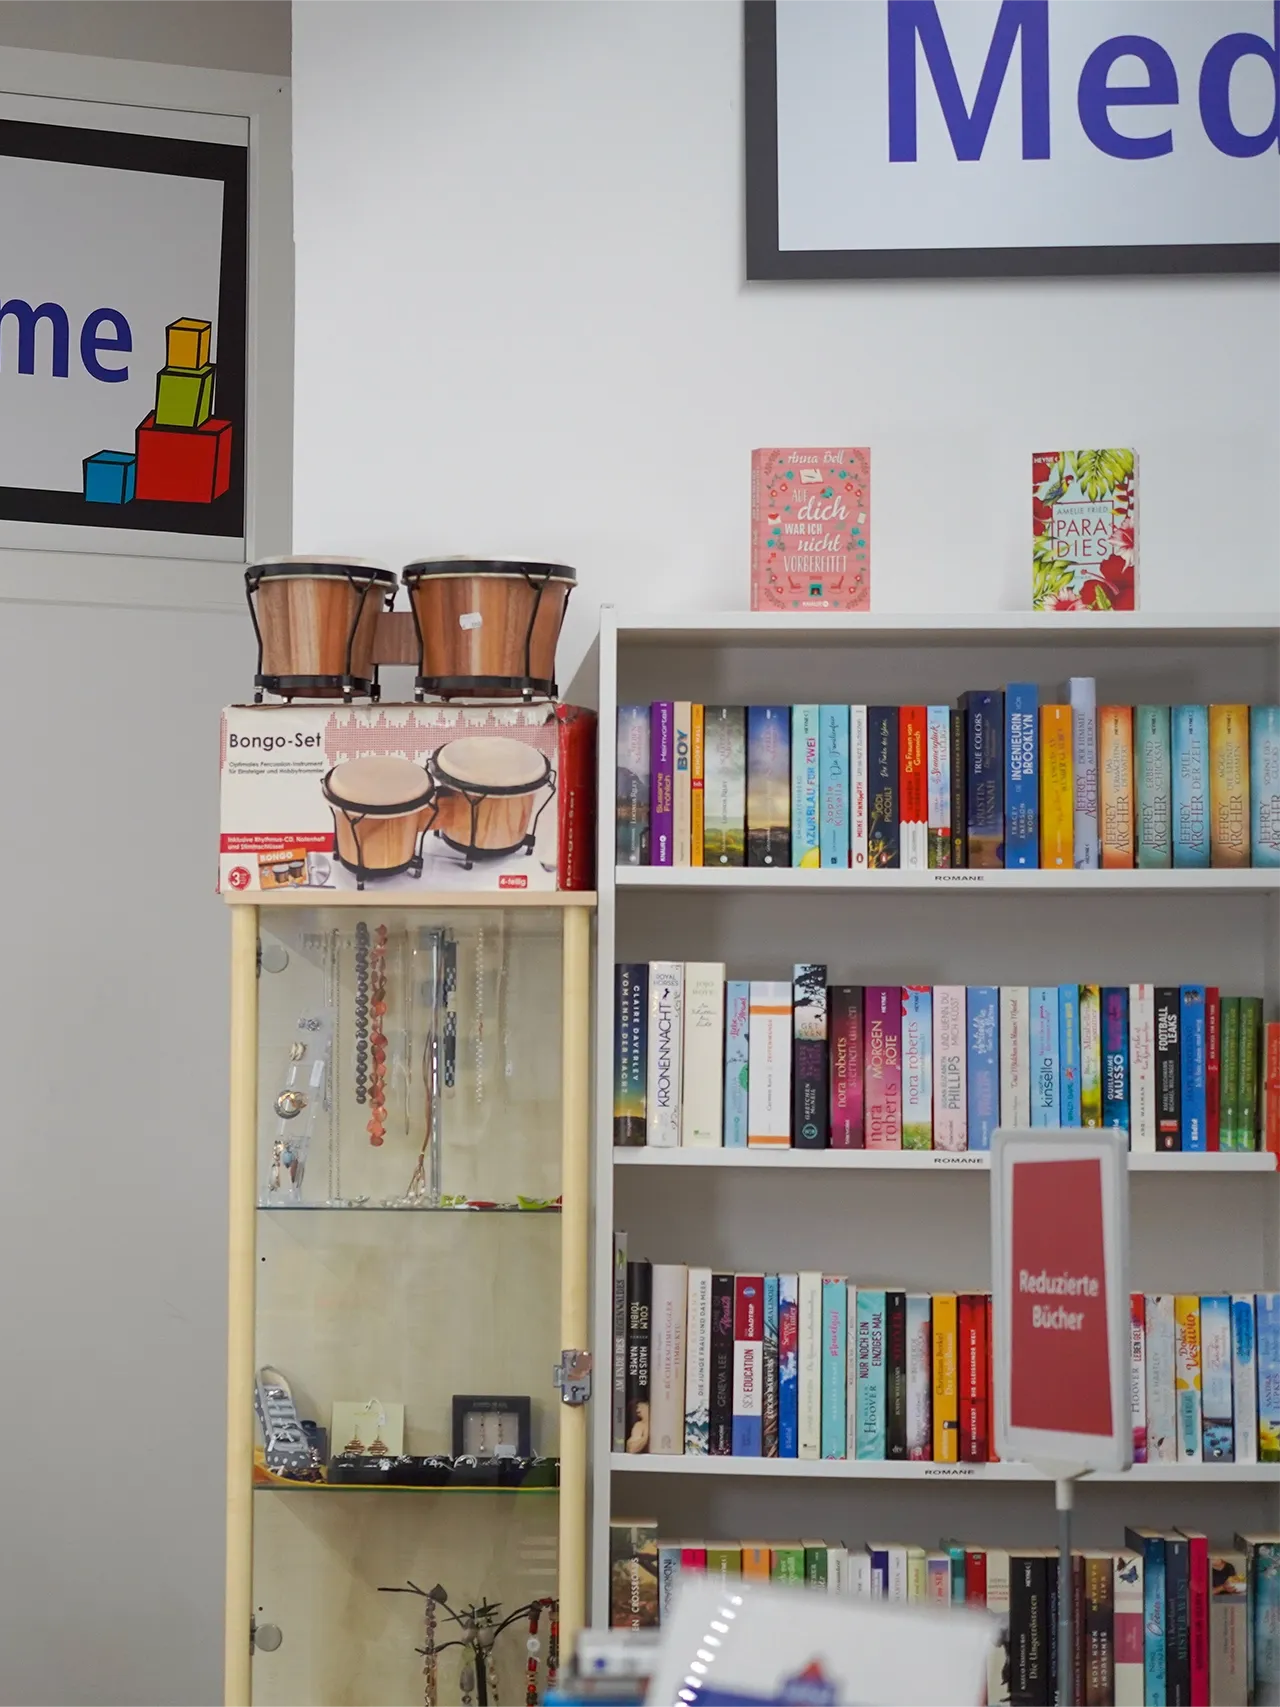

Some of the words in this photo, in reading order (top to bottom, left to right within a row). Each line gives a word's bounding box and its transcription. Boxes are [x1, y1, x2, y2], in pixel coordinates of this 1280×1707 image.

[888, 0, 1280, 162] Med
[788, 452, 818, 464] Anna
[823, 450, 843, 464] Bell
[798, 496, 850, 520] dich
[785, 524, 805, 534] WAR
[808, 524, 822, 534] ICH
[798, 533, 842, 552] nicht
[1057, 518, 1108, 537] PARA
[1057, 538, 1108, 558] DIES
[783, 555, 847, 572] VORBEREITET
[230, 732, 321, 751] Bongo-Set
[974, 713, 982, 750] COLORS
[1023, 714, 1033, 774] BROOKLYN
[676, 729, 688, 771] BOY
[806, 738, 815, 764] ZWEI
[1011, 713, 1022, 781] INGENIEURIN
[1192, 740, 1201, 763] ZEIT
[807, 767, 815, 785] FÜR
[1181, 750, 1191, 778] SPIEL
[1192, 765, 1201, 789] DER
[663, 775, 671, 812] Fröhlich
[825, 786, 834, 823] Sophie
[834, 783, 843, 826] Kinsella
[875, 793, 884, 814] JODI
[884, 787, 892, 822] PICOULT
[976, 782, 985, 825] KRISTIN
[1076, 774, 1089, 812] JEFFREY
[1086, 768, 1096, 819] ARCHER
[806, 788, 816, 846] AZURBLAU
[1104, 802, 1118, 845] JEFFREY
[1117, 796, 1130, 854] ARCHER
[1141, 802, 1153, 845] JEFFREY
[1153, 795, 1167, 854] ARCHER
[1179, 802, 1193, 845] JEFFREY
[1191, 794, 1204, 854] ARCHER
[1218, 802, 1231, 845] JEFFREY
[1230, 795, 1243, 854] ARCHER
[1258, 800, 1273, 844] JEFFREY
[260, 852, 293, 861] BONGO
[232, 872, 240, 886] 3
[941, 992, 949, 1004] DU
[941, 1006, 949, 1031] WENN
[1158, 1007, 1168, 1051] FOOTBALL
[1168, 1014, 1177, 1043] LEAKS
[872, 1020, 883, 1079] MORGEN
[883, 1035, 897, 1065] RÖTE
[905, 1021, 918, 1069] roberts
[941, 1032, 949, 1051] UND
[951, 1024, 959, 1046] MICH
[658, 1003, 671, 1108] KRONENNACHT
[835, 1037, 846, 1077] roberts
[907, 1075, 918, 1105] nora
[948, 1056, 960, 1109] PHILLIPS
[1041, 1058, 1053, 1108] kinsella
[1114, 1054, 1124, 1100] MUSSO
[837, 1082, 846, 1107] nora
[871, 1105, 882, 1141] nora
[882, 1083, 897, 1141] roberts
[1019, 1269, 1099, 1297] Reduzierte
[640, 1305, 648, 1330] COLM
[788, 1307, 797, 1333] Winter
[859, 1322, 868, 1336] EIN
[872, 1312, 882, 1329] MAL
[1032, 1305, 1084, 1331] Bücher
[616, 1338, 624, 1353] DES
[782, 1322, 791, 1345] Sense
[872, 1331, 882, 1366] EINZIGES
[1185, 1313, 1198, 1370] Vesuvio
[630, 1346, 638, 1376] NAMEN
[639, 1346, 647, 1366] HAUS
[719, 1354, 727, 1369] LEE
[859, 1338, 869, 1360] NOCH
[1133, 1341, 1141, 1362] LEBEN
[616, 1355, 624, 1377] ENDE
[639, 1368, 647, 1386] DER
[743, 1349, 754, 1392] EDUCATION
[859, 1362, 869, 1378] NUR
[616, 1378, 624, 1392] AM
[717, 1372, 727, 1407] GENEVA
[743, 1394, 753, 1409] SEX
[864, 1385, 877, 1433] HOOVER
[631, 1558, 640, 1613] CROSSROADS
